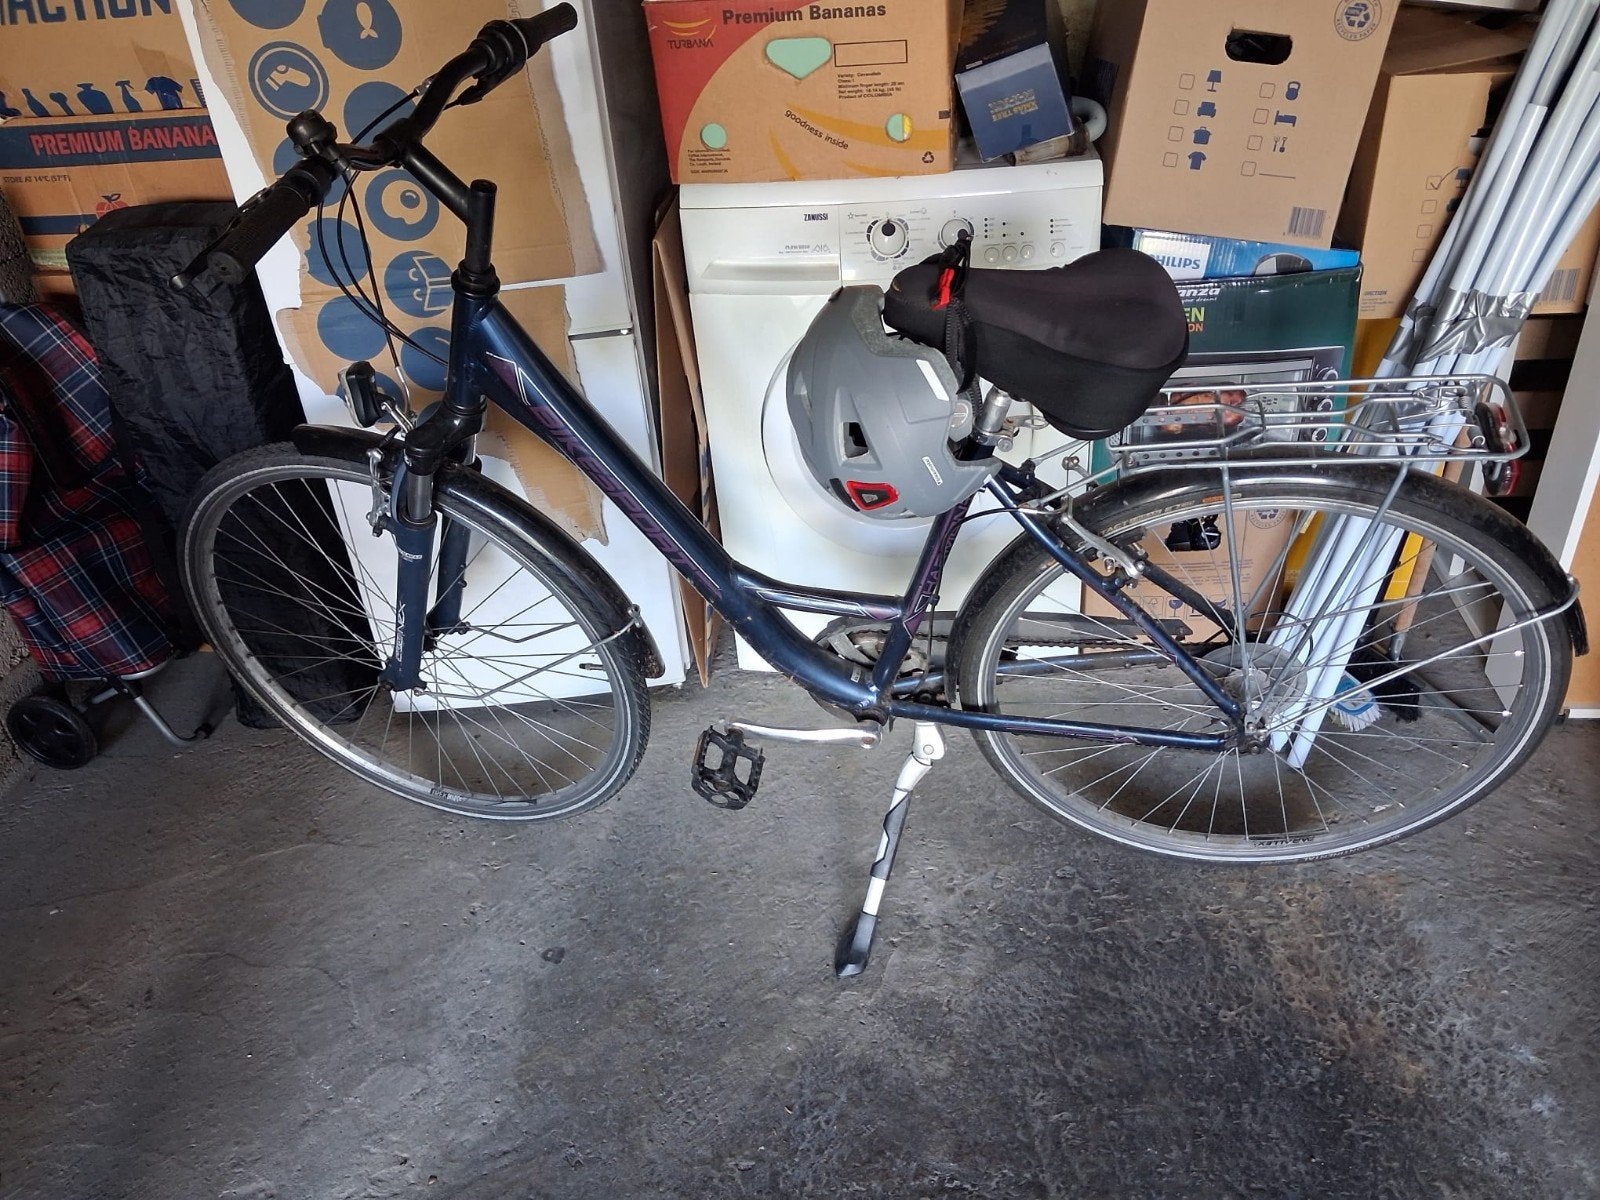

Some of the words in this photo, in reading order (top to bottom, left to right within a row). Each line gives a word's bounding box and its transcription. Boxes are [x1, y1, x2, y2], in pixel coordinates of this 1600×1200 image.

[722, 8, 803, 25] Premium
[809, 4, 886, 20] Bananas
[667, 38, 714, 49] TURBANA
[784, 109, 823, 138] goodness
[825, 134, 849, 150] inside
[30, 130, 123, 156] PREMIUM
[803, 213, 829, 221] ZANUSSI
[1151, 254, 1201, 270] HILIPS
